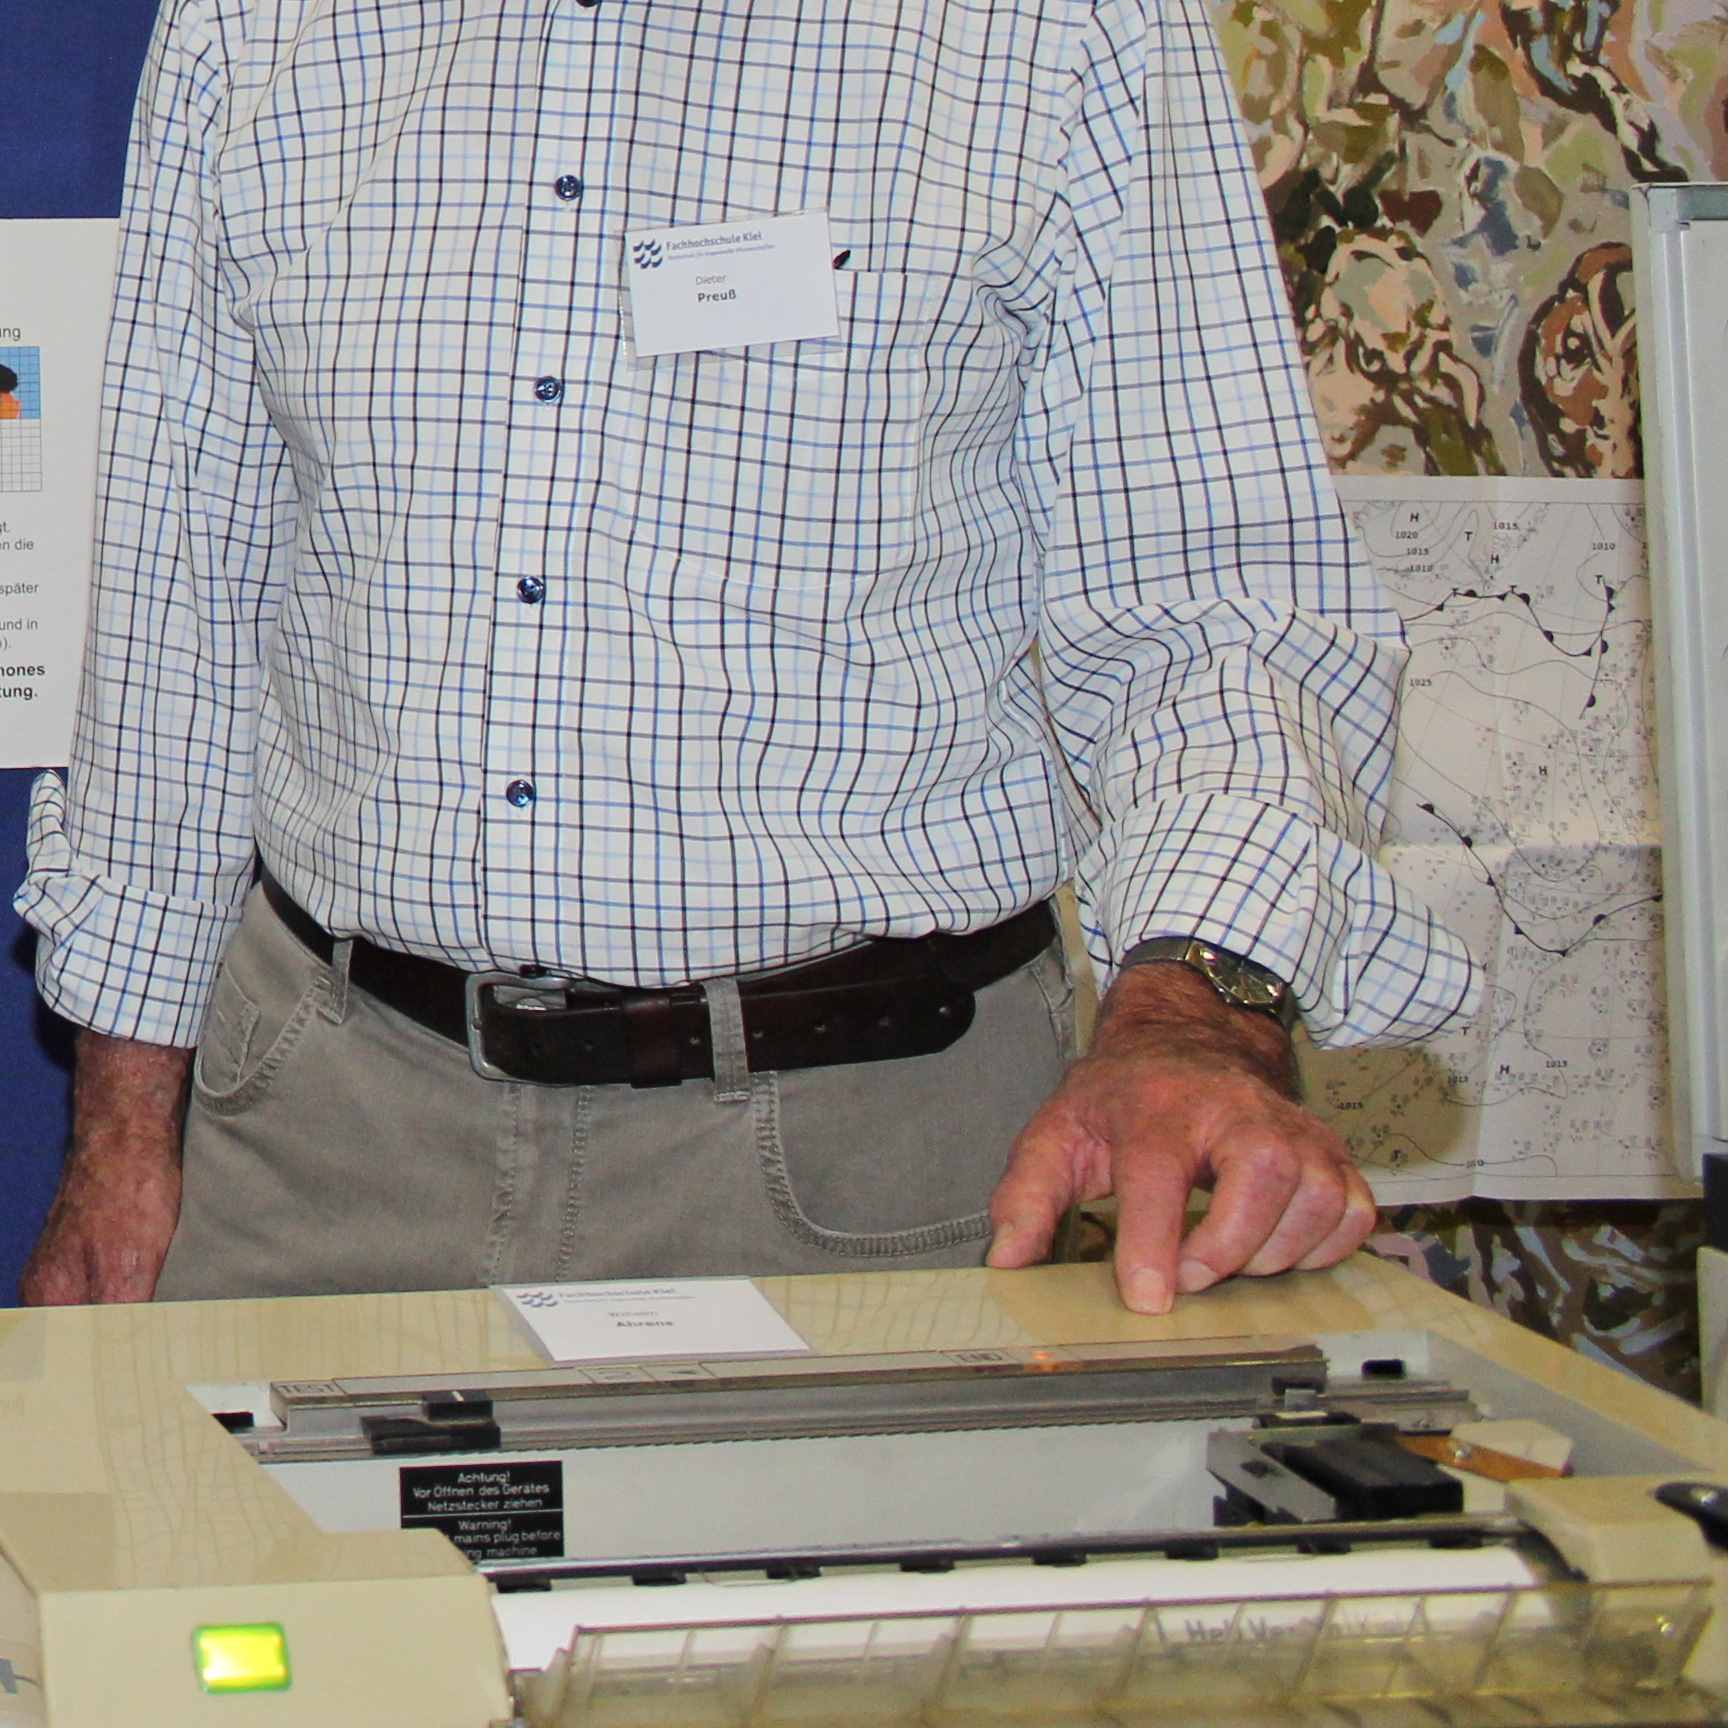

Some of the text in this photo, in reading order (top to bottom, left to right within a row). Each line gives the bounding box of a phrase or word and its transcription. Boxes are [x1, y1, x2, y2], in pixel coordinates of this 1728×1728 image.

[698, 289, 736, 302] Preuß
[15, 538, 34, 550] die
[457, 1471, 510, 1484] Achtung!
